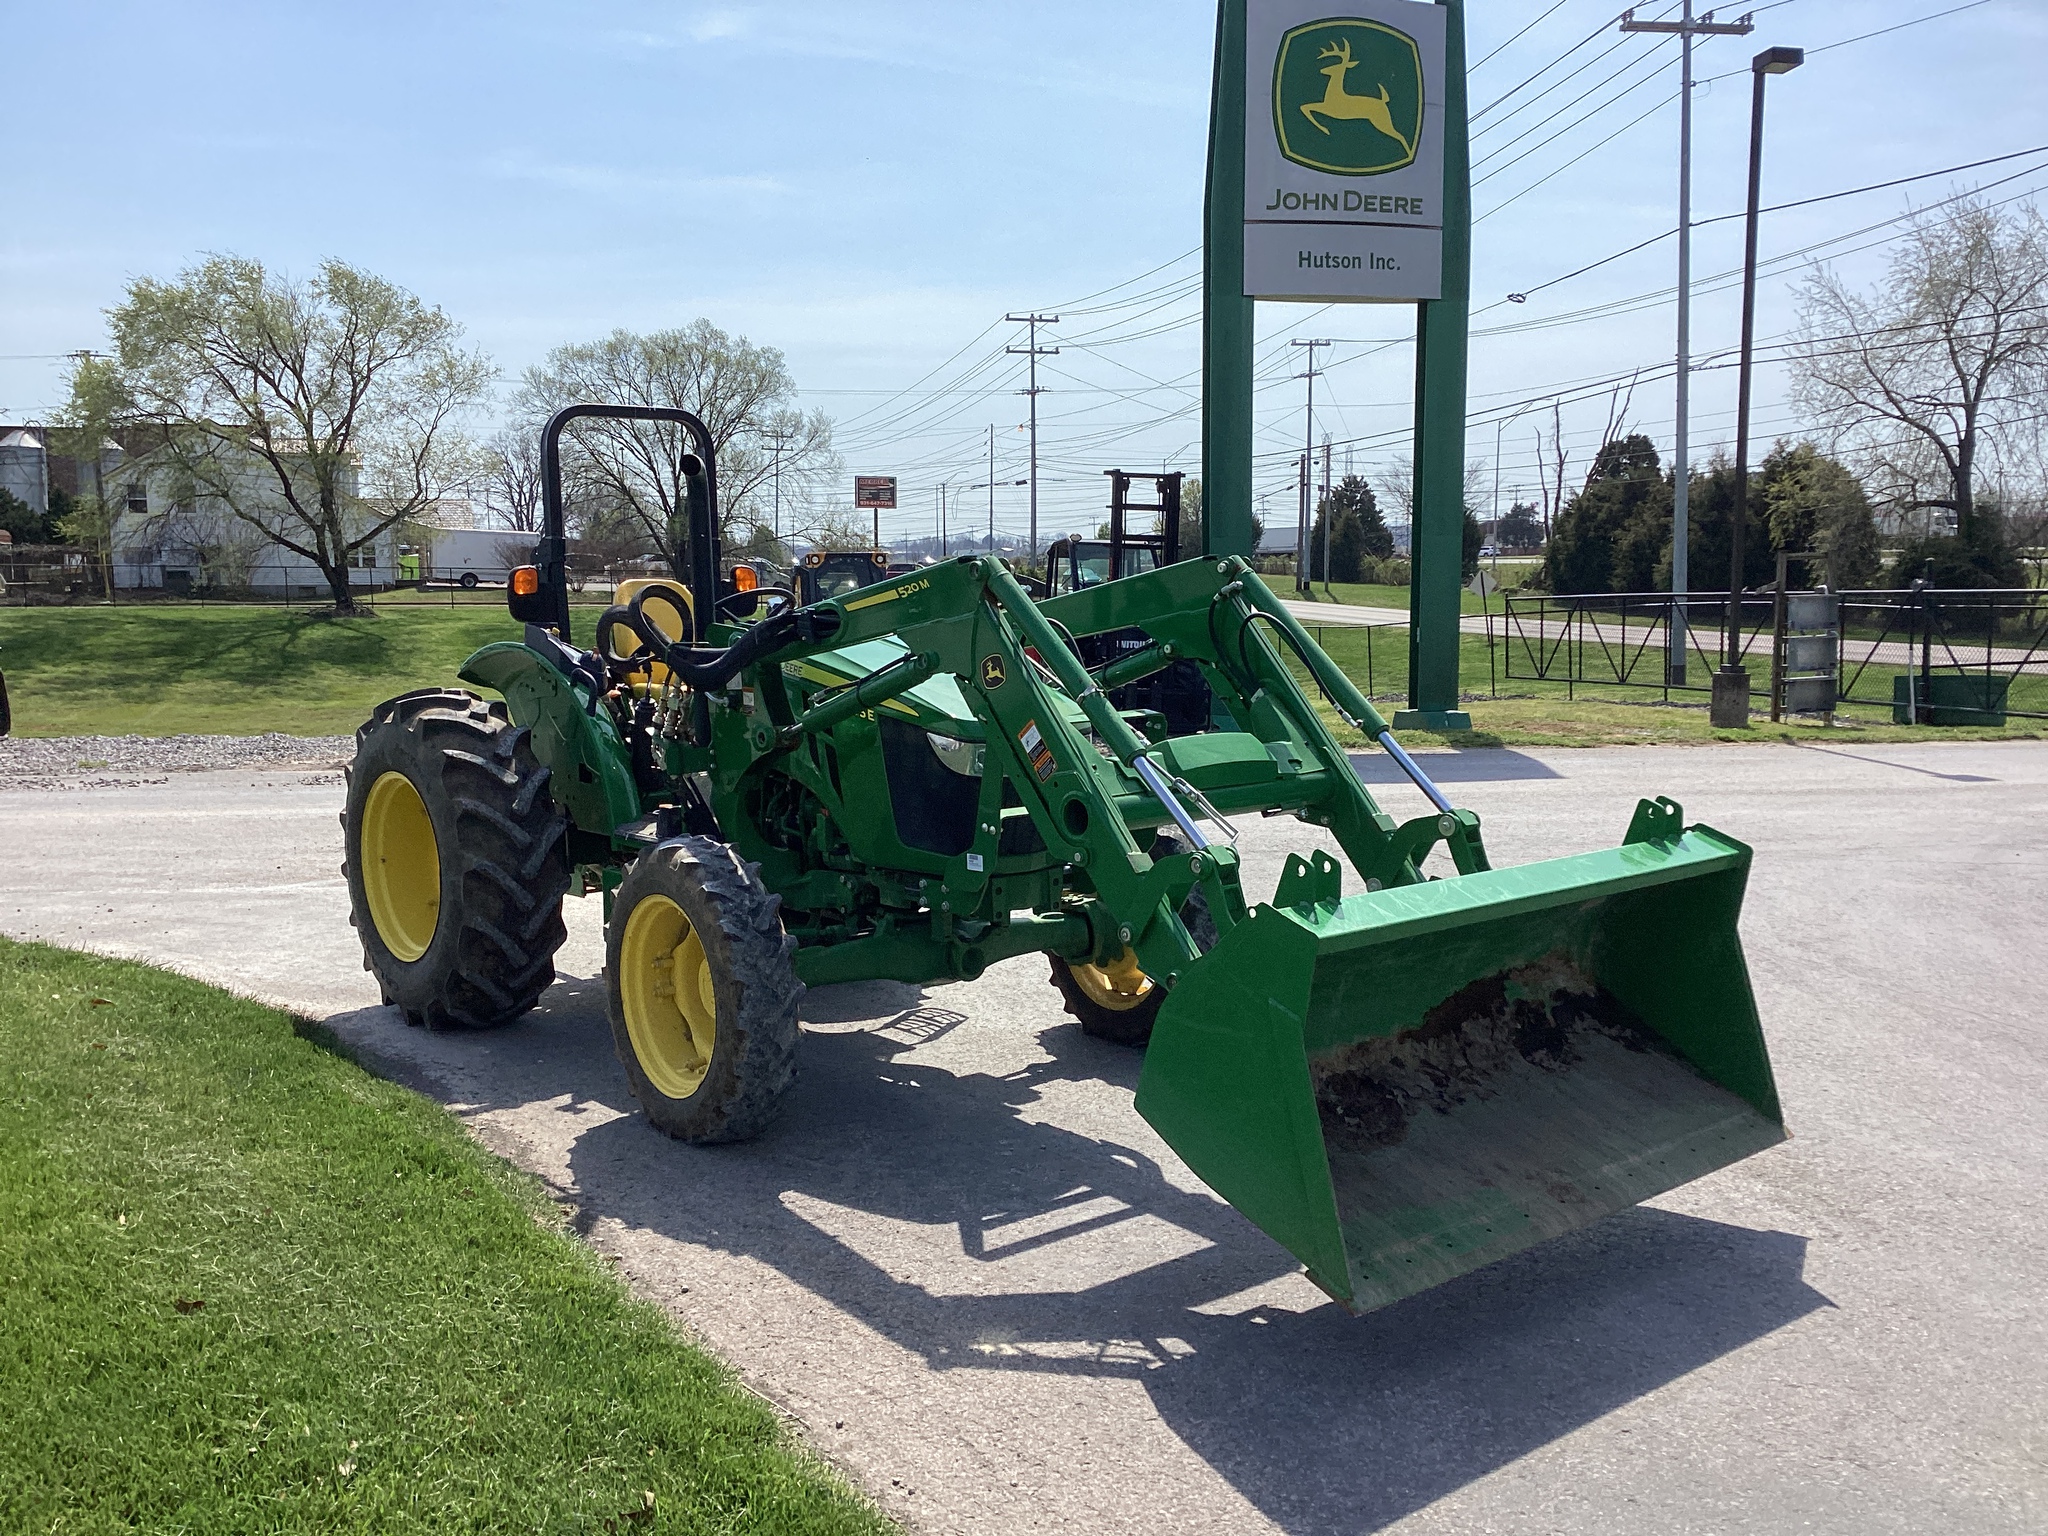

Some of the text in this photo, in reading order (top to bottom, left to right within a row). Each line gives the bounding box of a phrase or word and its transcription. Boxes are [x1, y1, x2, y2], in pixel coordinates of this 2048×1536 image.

[1266, 189, 1423, 215] JOHN DEERE
[1298, 251, 1401, 271] Hutson Inc.
